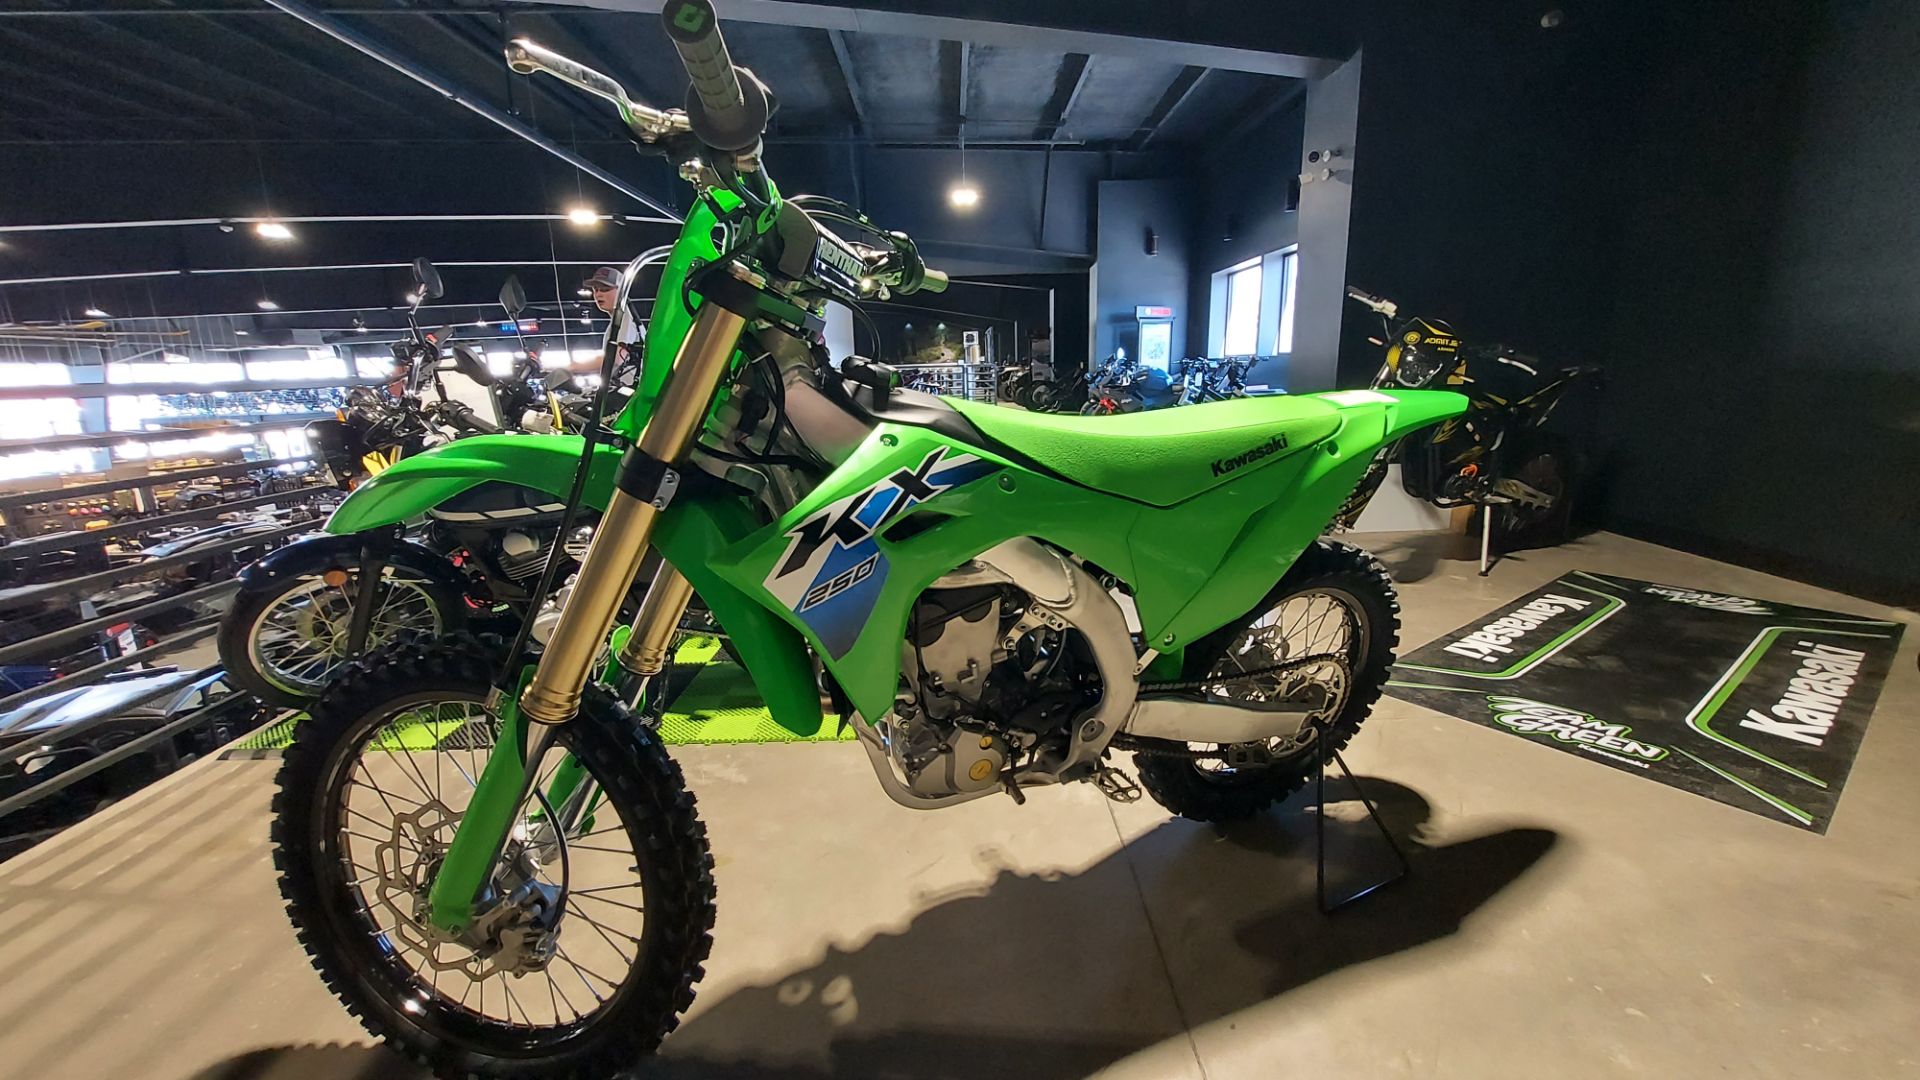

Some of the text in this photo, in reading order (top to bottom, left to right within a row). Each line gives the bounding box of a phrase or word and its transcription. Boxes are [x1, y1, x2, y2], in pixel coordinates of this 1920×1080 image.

[818, 236, 864, 281] RENTHAL
[1211, 432, 1289, 478] Kawasaki
[775, 447, 949, 581] KX
[802, 553, 879, 613] 250
[1443, 593, 1593, 663] Kawasaki
[1489, 696, 1627, 737] TEAM
[1739, 640, 1866, 747] Kawasaki
[1499, 713, 1663, 758] GREEN
